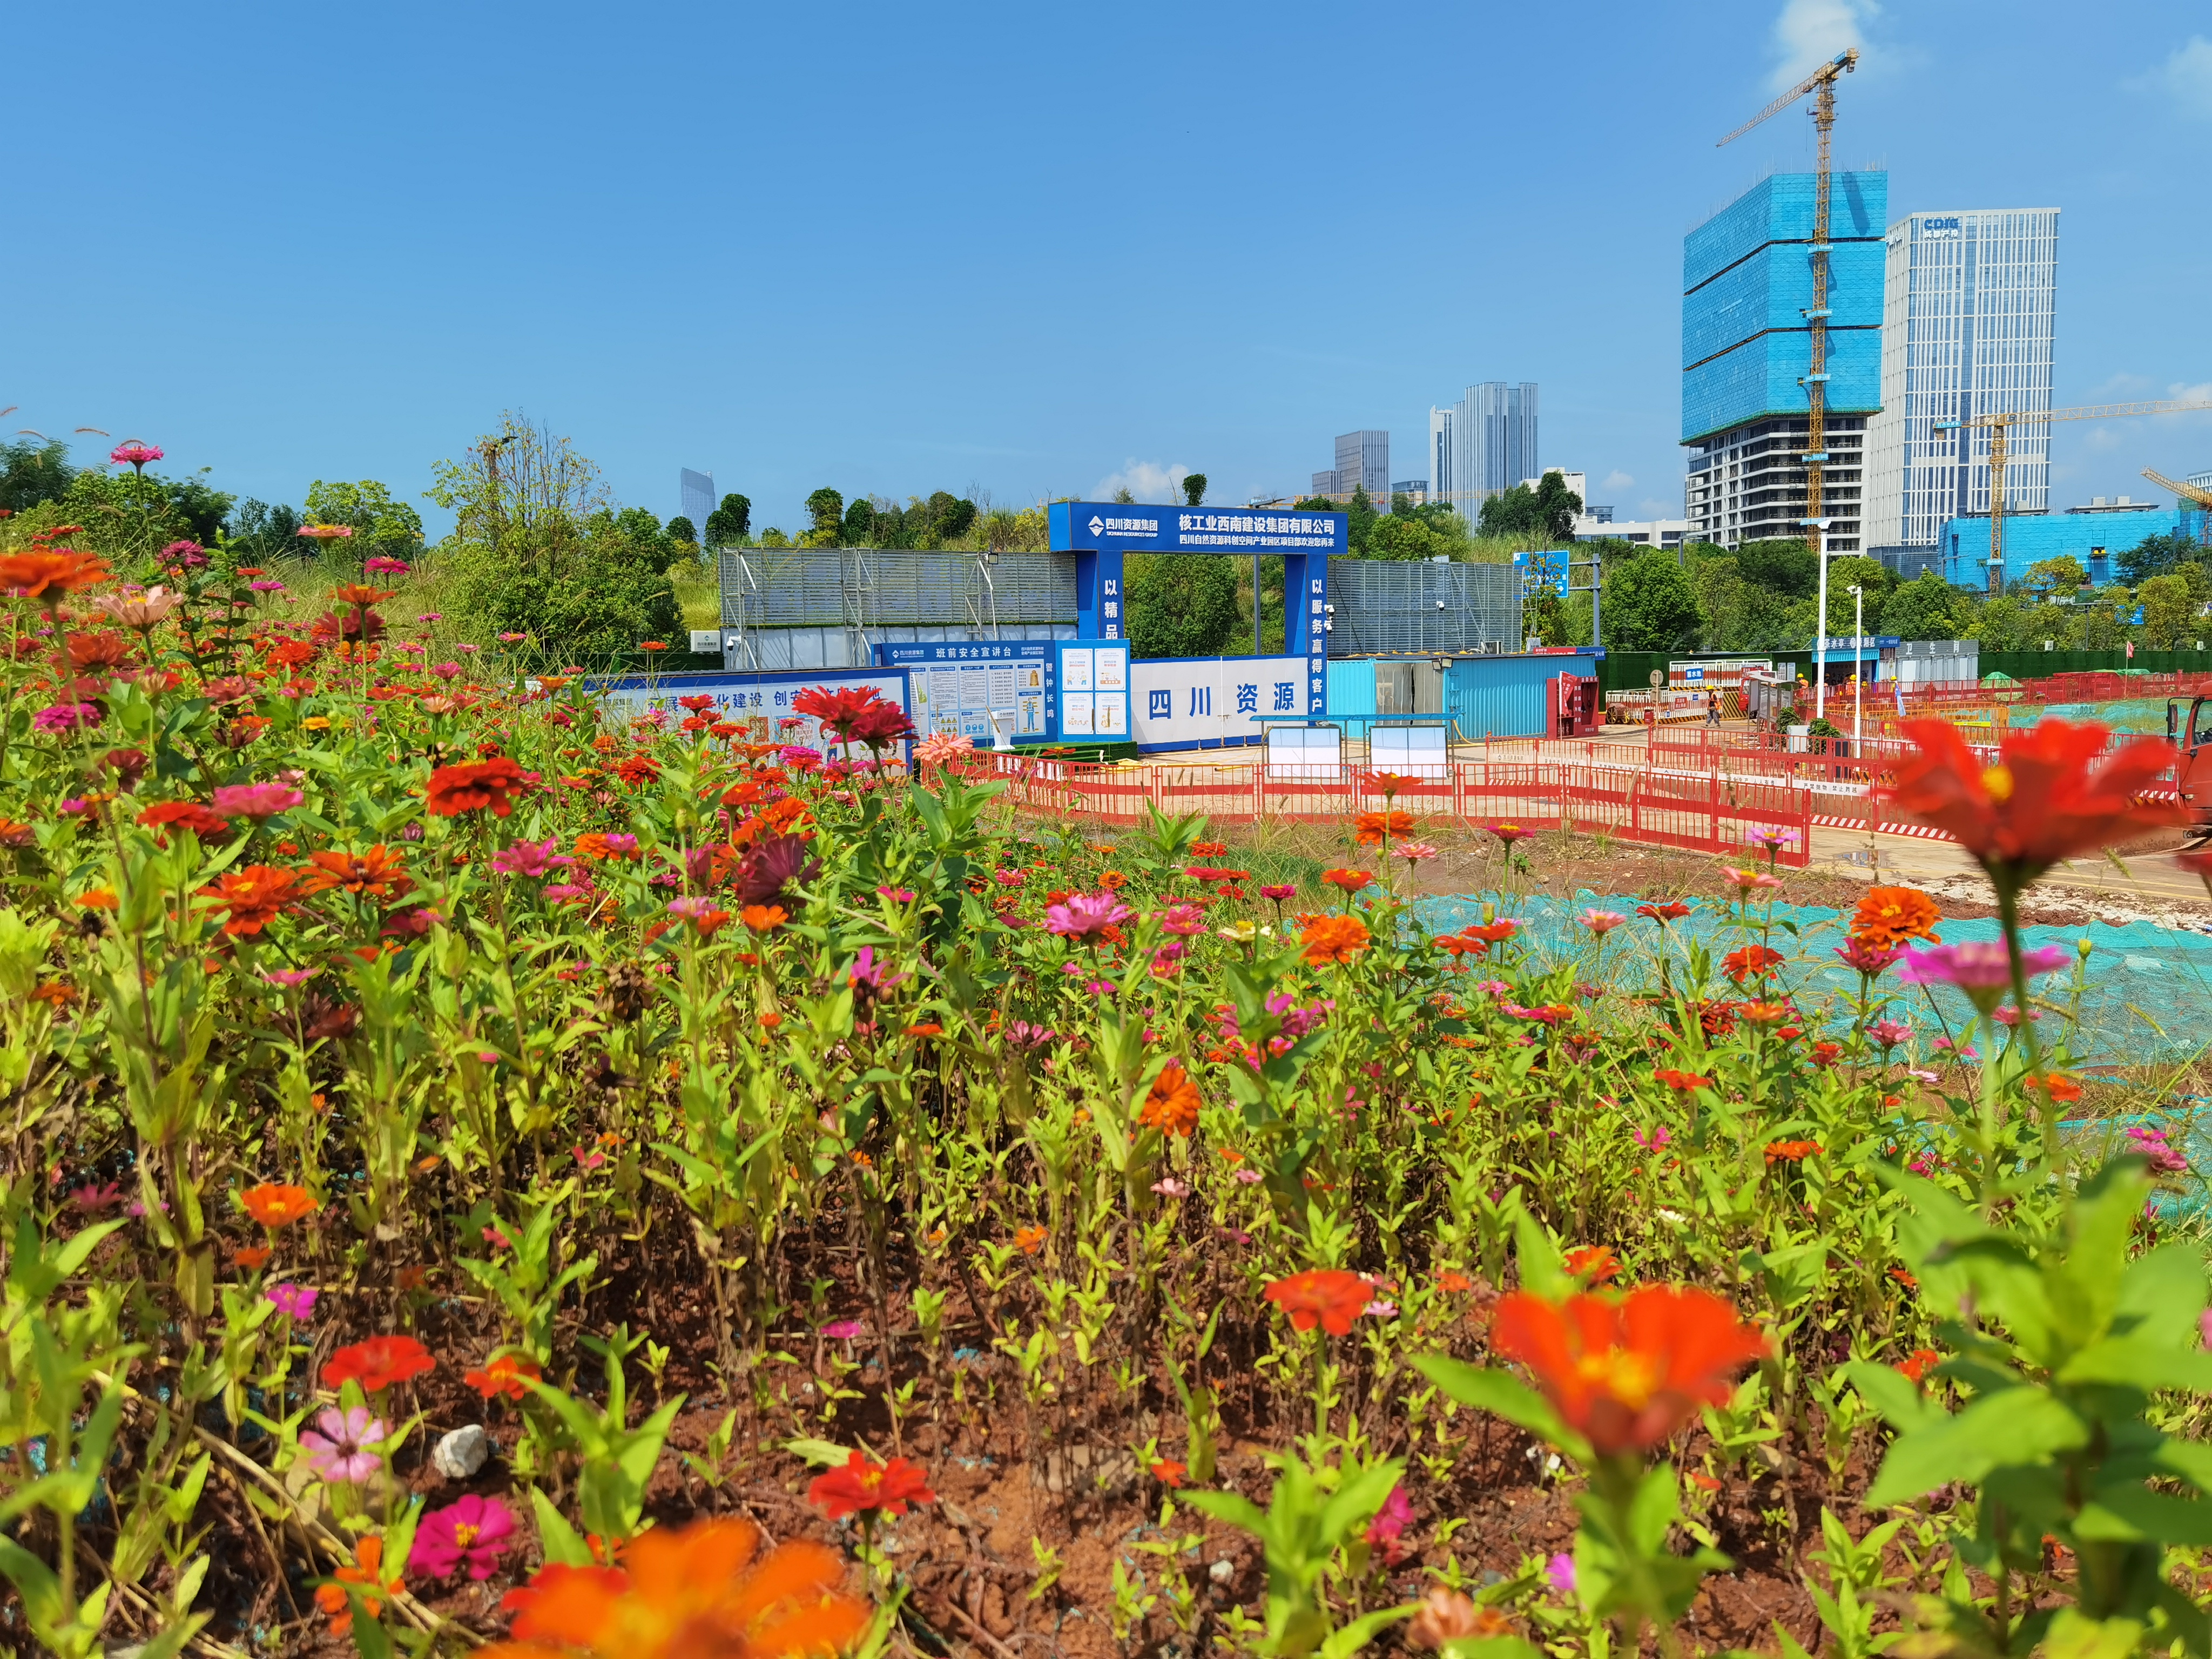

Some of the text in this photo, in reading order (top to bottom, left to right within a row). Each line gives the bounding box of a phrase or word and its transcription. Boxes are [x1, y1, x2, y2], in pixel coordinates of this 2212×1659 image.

[1924, 218, 1958, 230] CDIG
[1105, 518, 1158, 531] 四川资源集团
[1179, 514, 1334, 535] 核工业西南建设集团有限公司
[1179, 534, 1334, 547] 四川自然资源科创空间产业园区项目部欢迎您再来
[936, 647, 1011, 658] 班前安全宣讲台
[1312, 579, 1323, 712] 以服务赢得客户
[1906, 640, 1959, 655] 卫生间
[1046, 663, 1054, 718] 警钟长鸣
[1149, 682, 1294, 720] 四川资源
[1832, 785, 1857, 793] 禁止跨越
